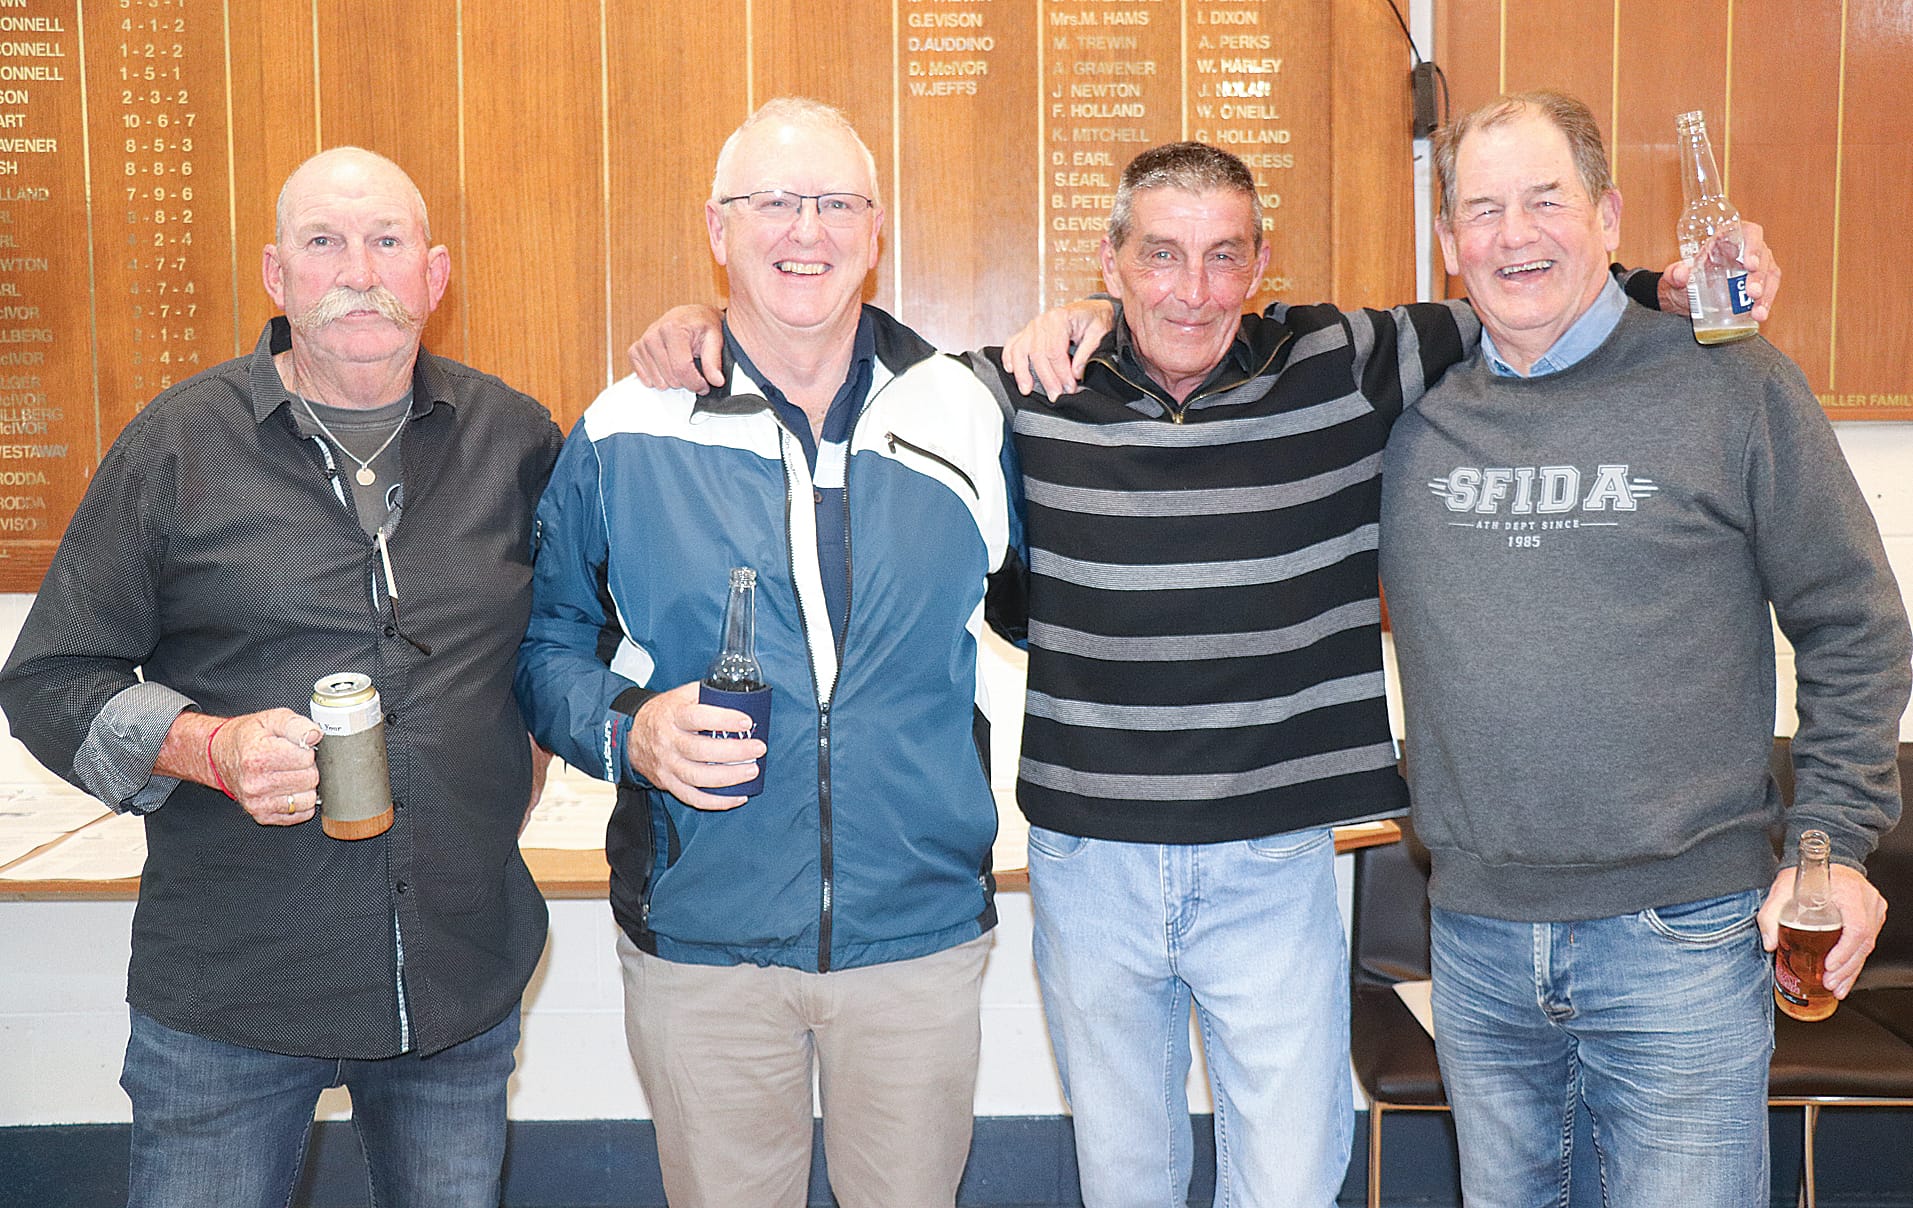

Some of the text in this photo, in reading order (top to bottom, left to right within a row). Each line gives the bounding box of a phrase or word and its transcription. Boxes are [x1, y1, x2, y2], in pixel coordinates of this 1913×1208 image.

[0, 17, 65, 32] ONNELL
[1103, 10, 1150, 26] HAMS
[1210, 10, 1259, 25] DIXON
[0, 42, 65, 57] ONNELL
[1076, 36, 1137, 50] TREWIN
[1220, 35, 1271, 49] PERKS
[1073, 61, 1157, 76] GRAVENER
[1221, 58, 1282, 74] HARLEY
[1071, 83, 1142, 98] NEWTON
[1071, 103, 1146, 118] HOLLAND
[1220, 103, 1280, 120] O'NEILL
[1072, 127, 1151, 143] MITCHELL
[1216, 128, 1291, 144] HOLLAND
[1073, 151, 1115, 167] EARL
[1071, 194, 1115, 209] PETE
[1870, 394, 1913, 407] FAMIL
[0, 444, 69, 459] ESTAWAY
[1445, 464, 1637, 514] SFIDA
[1476, 519, 1580, 531] ATH DEPT SINCE
[1507, 535, 1541, 548] 1985
